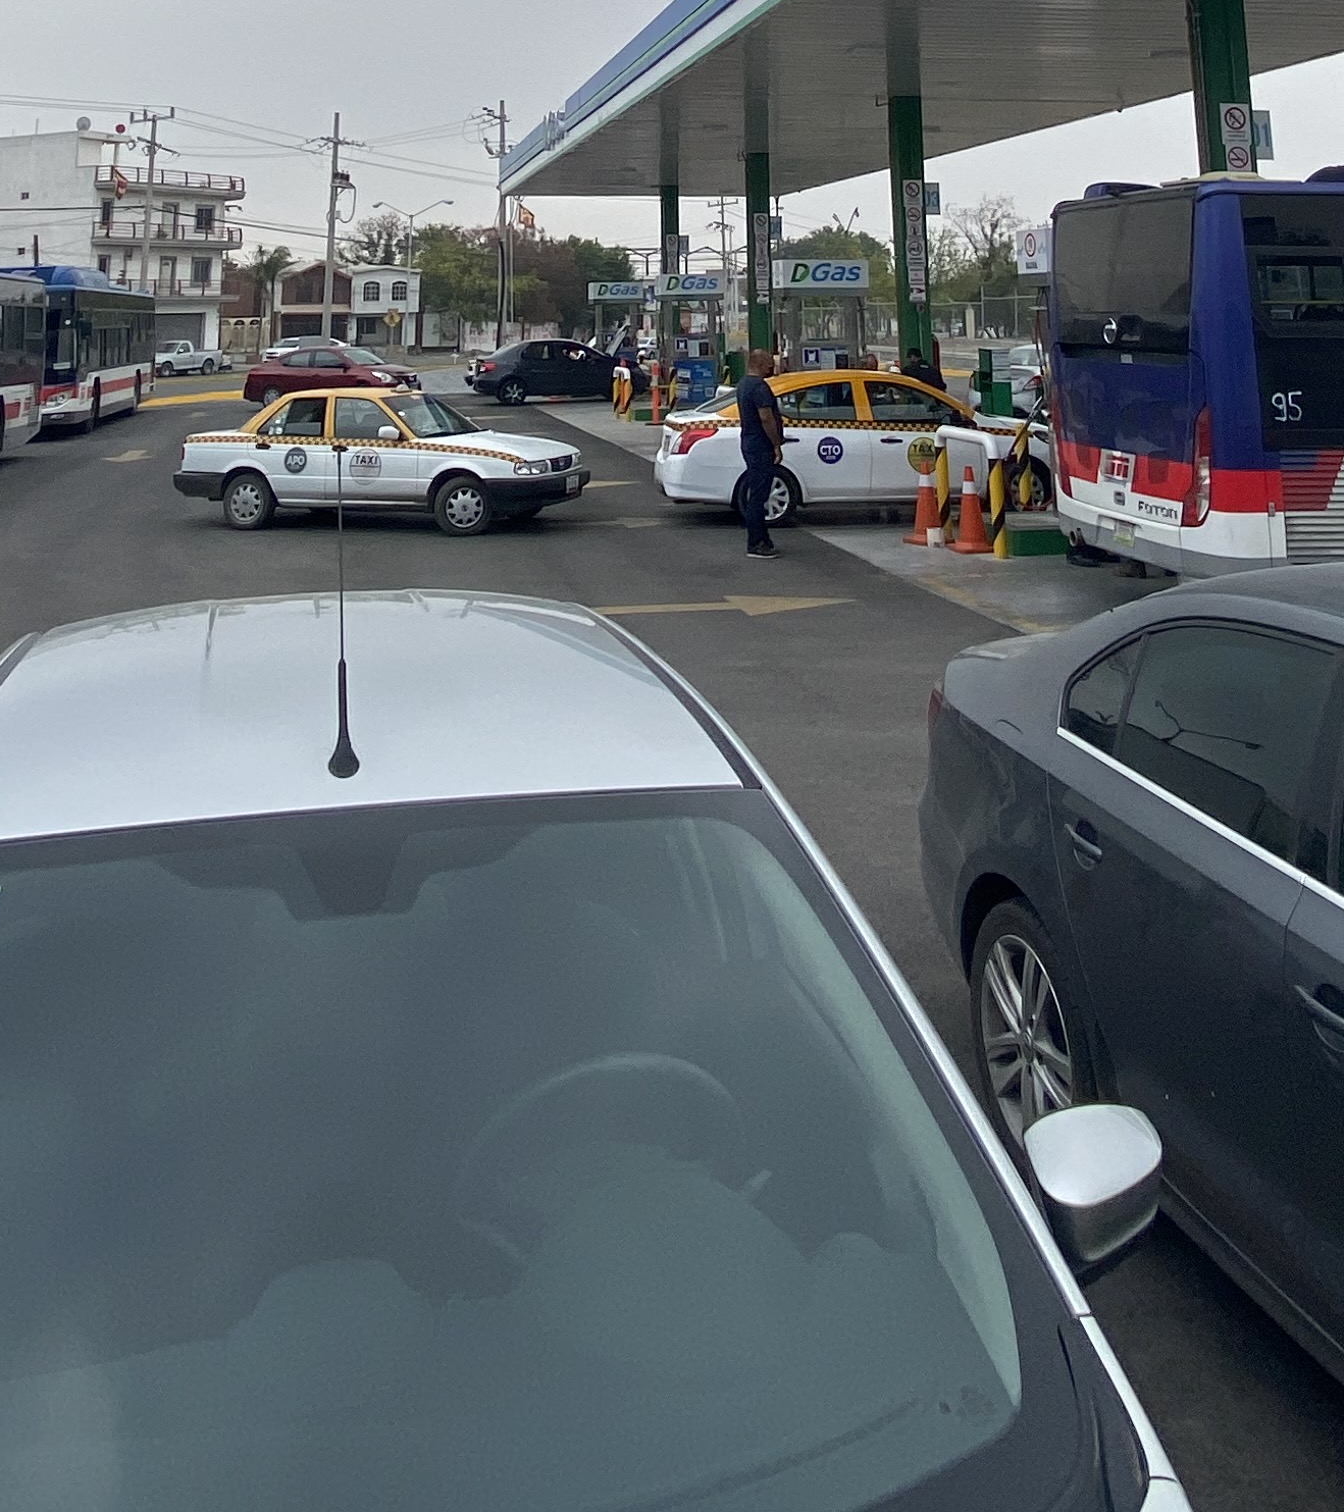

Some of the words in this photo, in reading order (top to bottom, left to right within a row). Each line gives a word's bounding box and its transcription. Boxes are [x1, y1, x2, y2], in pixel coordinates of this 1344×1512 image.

[790, 262, 862, 283] DGas
[666, 276, 719, 291] DGas
[597, 284, 639, 296] DGas
[1271, 391, 1303, 422] 95
[819, 444, 841, 456] CTO
[912, 443, 935, 455] TAX
[355, 454, 378, 465] TAXI
